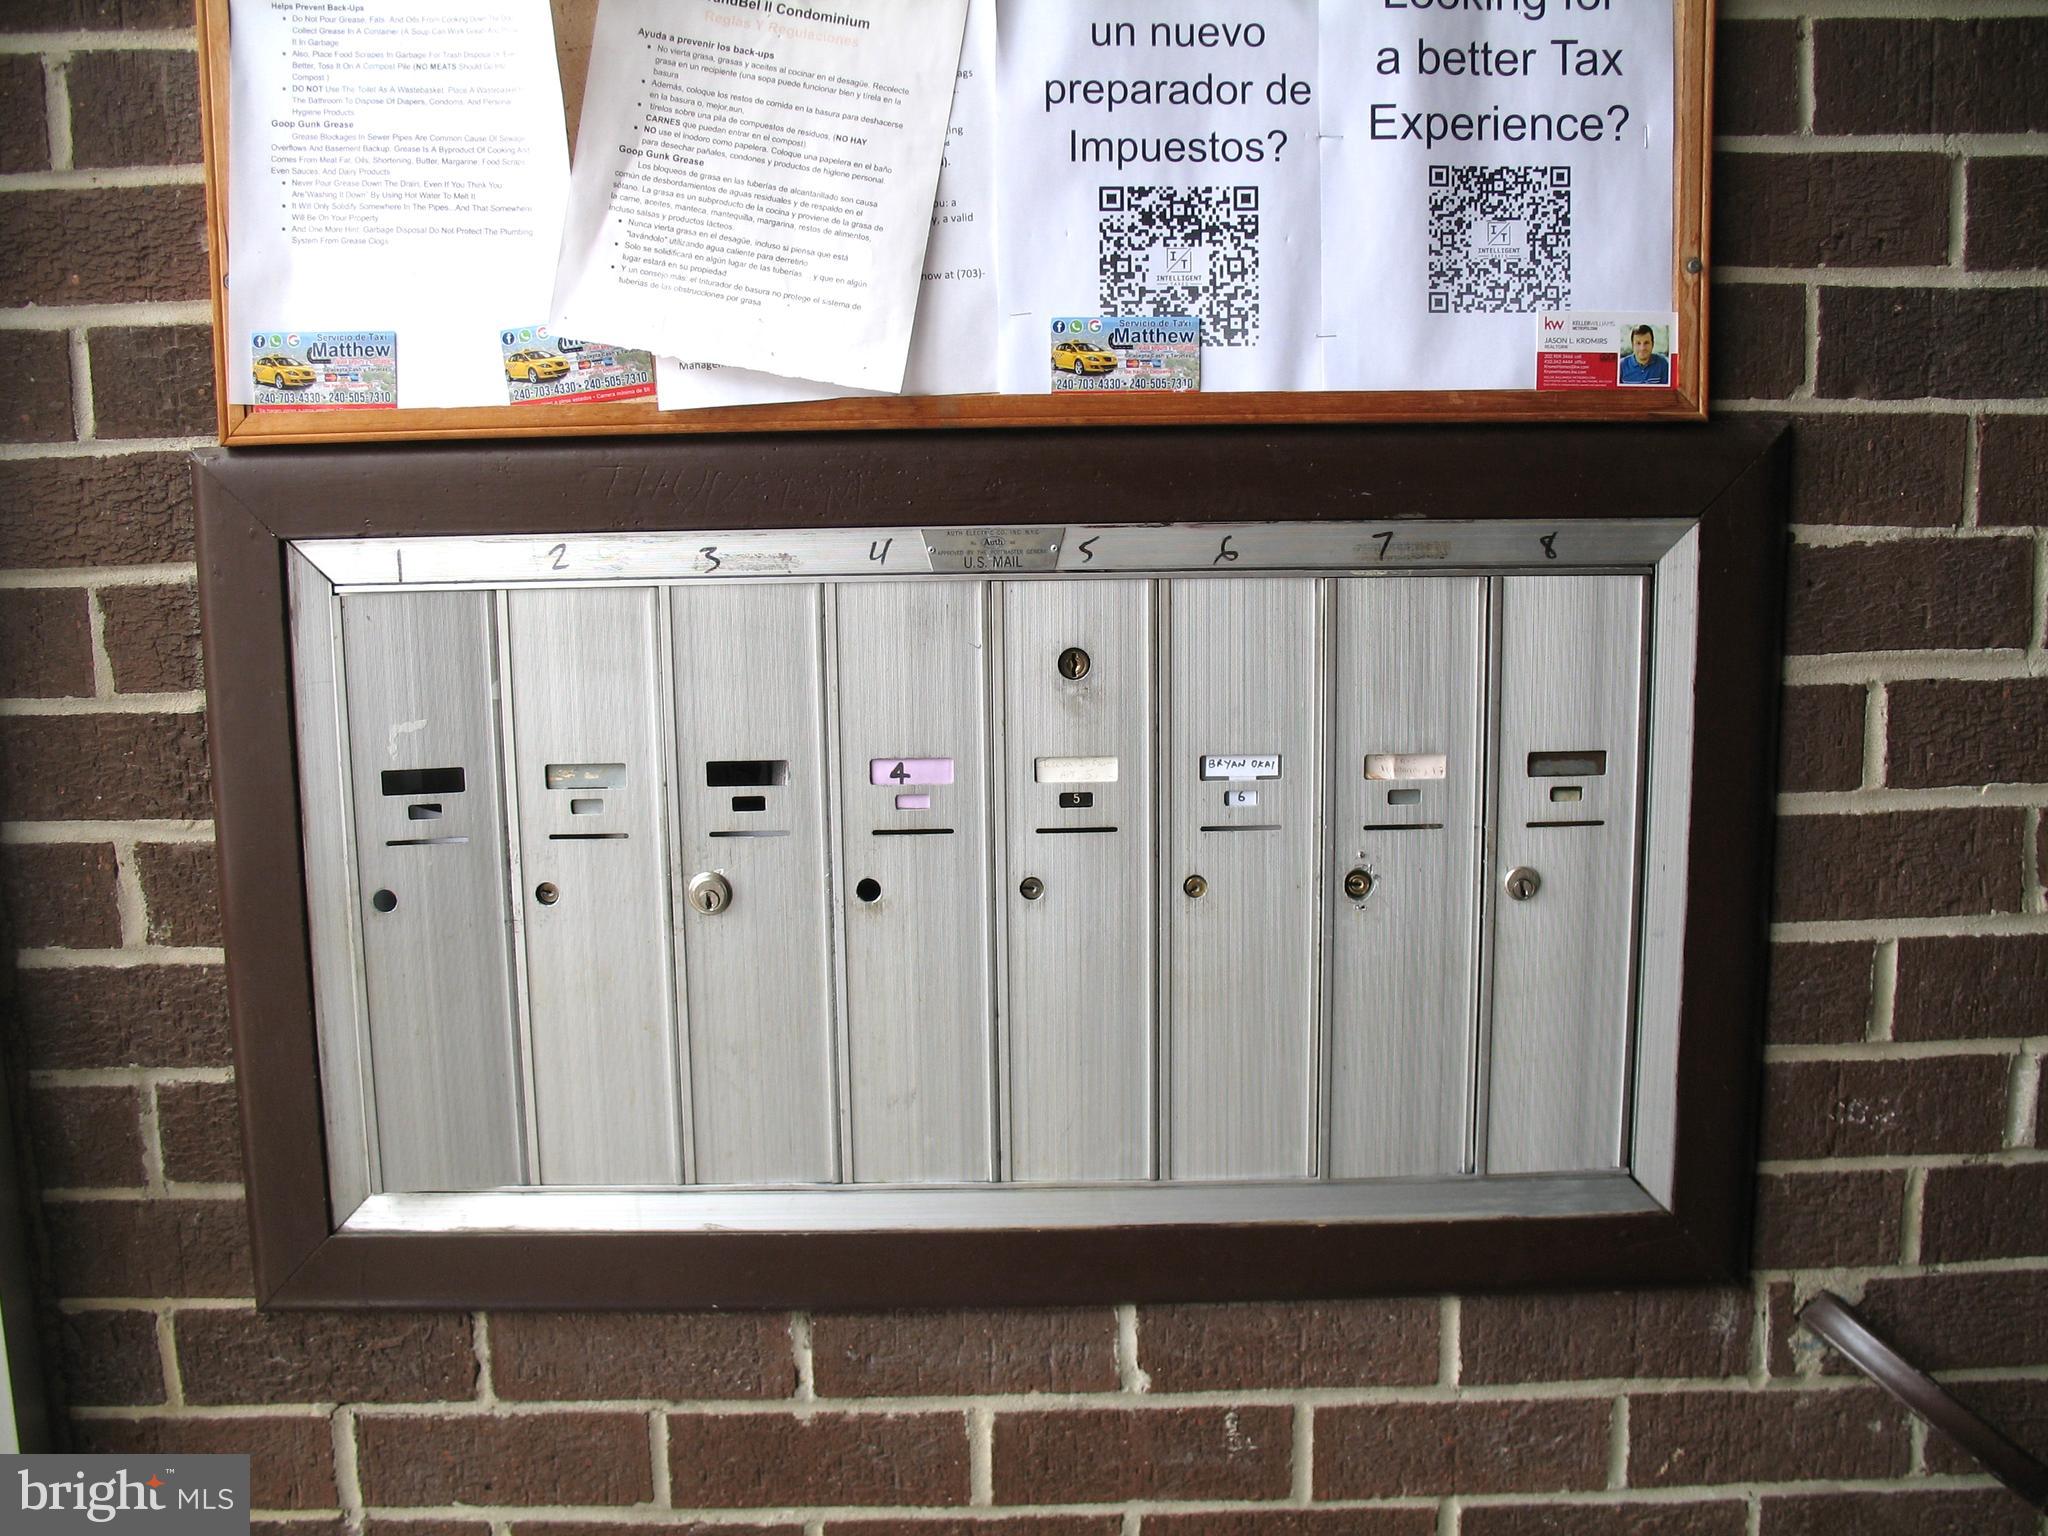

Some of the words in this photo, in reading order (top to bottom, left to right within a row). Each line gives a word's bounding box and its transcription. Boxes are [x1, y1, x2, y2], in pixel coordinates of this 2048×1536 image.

[271, 1, 294, 12] Helps
[295, 2, 326, 12] Prevent
[327, 3, 364, 13] Back-Ups
[776, 3, 871, 29] Condominium
[1091, 22, 1136, 47] un
[1150, 22, 1267, 47] nuevo
[638, 25, 668, 41] Ayuda
[668, 32, 676, 42] a
[676, 32, 716, 50] prevenir
[716, 40, 732, 53] los
[732, 43, 775, 61] back-ups
[1376, 47, 1401, 75] a
[1418, 38, 1537, 76] better
[1550, 39, 1624, 76] Tax
[292, 84, 305, 93] DO
[306, 84, 323, 93] NOT
[1045, 73, 1254, 113] preparador
[1266, 73, 1312, 105] de
[271, 119, 296, 129] Goop
[297, 119, 321, 129] Gunk
[323, 119, 354, 129] Grease
[1370, 104, 1631, 150] Experience?
[618, 144, 645, 158] Goop
[645, 148, 671, 162] Gunk
[671, 152, 705, 169] Grease
[1070, 129, 1288, 170] Impuestos?
[951, 212, 974, 223] valid
[945, 271, 954, 279] at
[1119, 319, 1156, 327] Servicio
[1159, 319, 1170, 327] de
[1172, 319, 1192, 327] Taxi
[1544, 316, 1565, 331] kw
[317, 333, 353, 341] Servicio
[355, 333, 366, 341] de
[368, 332, 388, 341] Taxi
[1114, 328, 1195, 344] Matthew
[312, 342, 391, 358] Matthew
[514, 382, 577, 400] 240-703-4330
[584, 371, 648, 390] 240-505-7310
[1057, 378, 1121, 390] 240-703-4330
[1129, 378, 1193, 389] 240-505-7310
[259, 391, 320, 404] 240-703-4330
[329, 391, 391, 403] 240-505-7310
[984, 538, 1003, 547] Auth
[1213, 535, 1239, 565] 6
[1372, 531, 1394, 560] 7
[1540, 531, 1559, 559] 8
[548, 544, 571, 570] 2
[699, 546, 721, 573] 3
[869, 538, 893, 565] 4
[963, 556, 987, 568] U.S.
[992, 555, 1023, 568] MAIL
[1208, 759, 1246, 769] BRYAN
[1251, 759, 1276, 769] OKAI
[889, 761, 912, 785] 4
[1073, 793, 1080, 804] 5
[1238, 791, 1245, 802] 6
